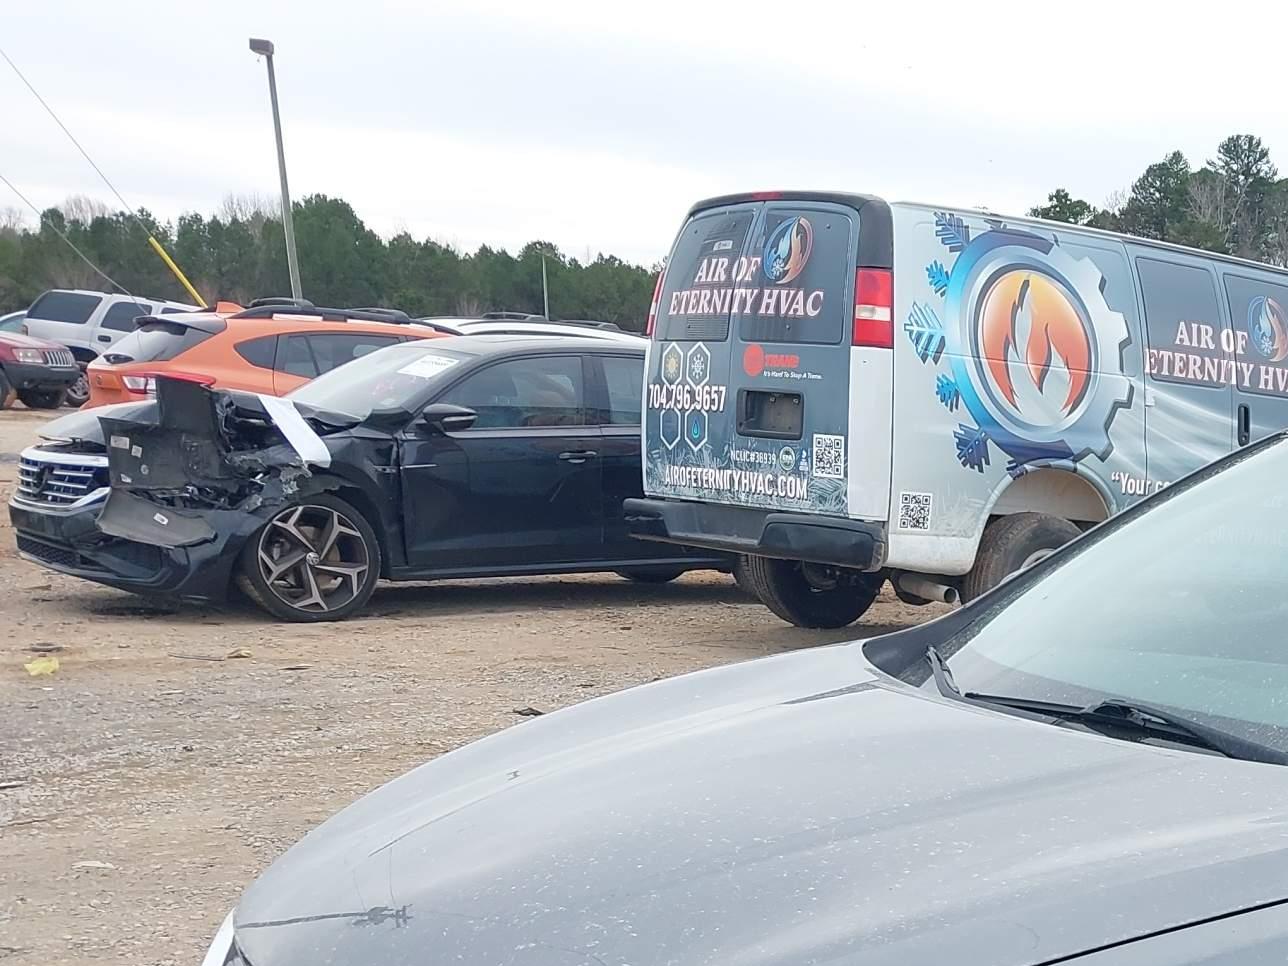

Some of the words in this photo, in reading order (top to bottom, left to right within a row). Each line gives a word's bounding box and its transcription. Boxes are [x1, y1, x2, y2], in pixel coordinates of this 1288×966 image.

[694, 257, 729, 283] AIR
[732, 256, 762, 282] OF
[668, 288, 758, 316] ETERNITY
[758, 289, 824, 317] HVAC
[1175, 321, 1216, 350] AIR
[1221, 328, 1248, 355] OF
[1144, 348, 1254, 388] ETERNITY
[649, 384, 726, 412] 704.796.9657
[664, 464, 808, 500] AIROFETERNITYHVAC.COM
